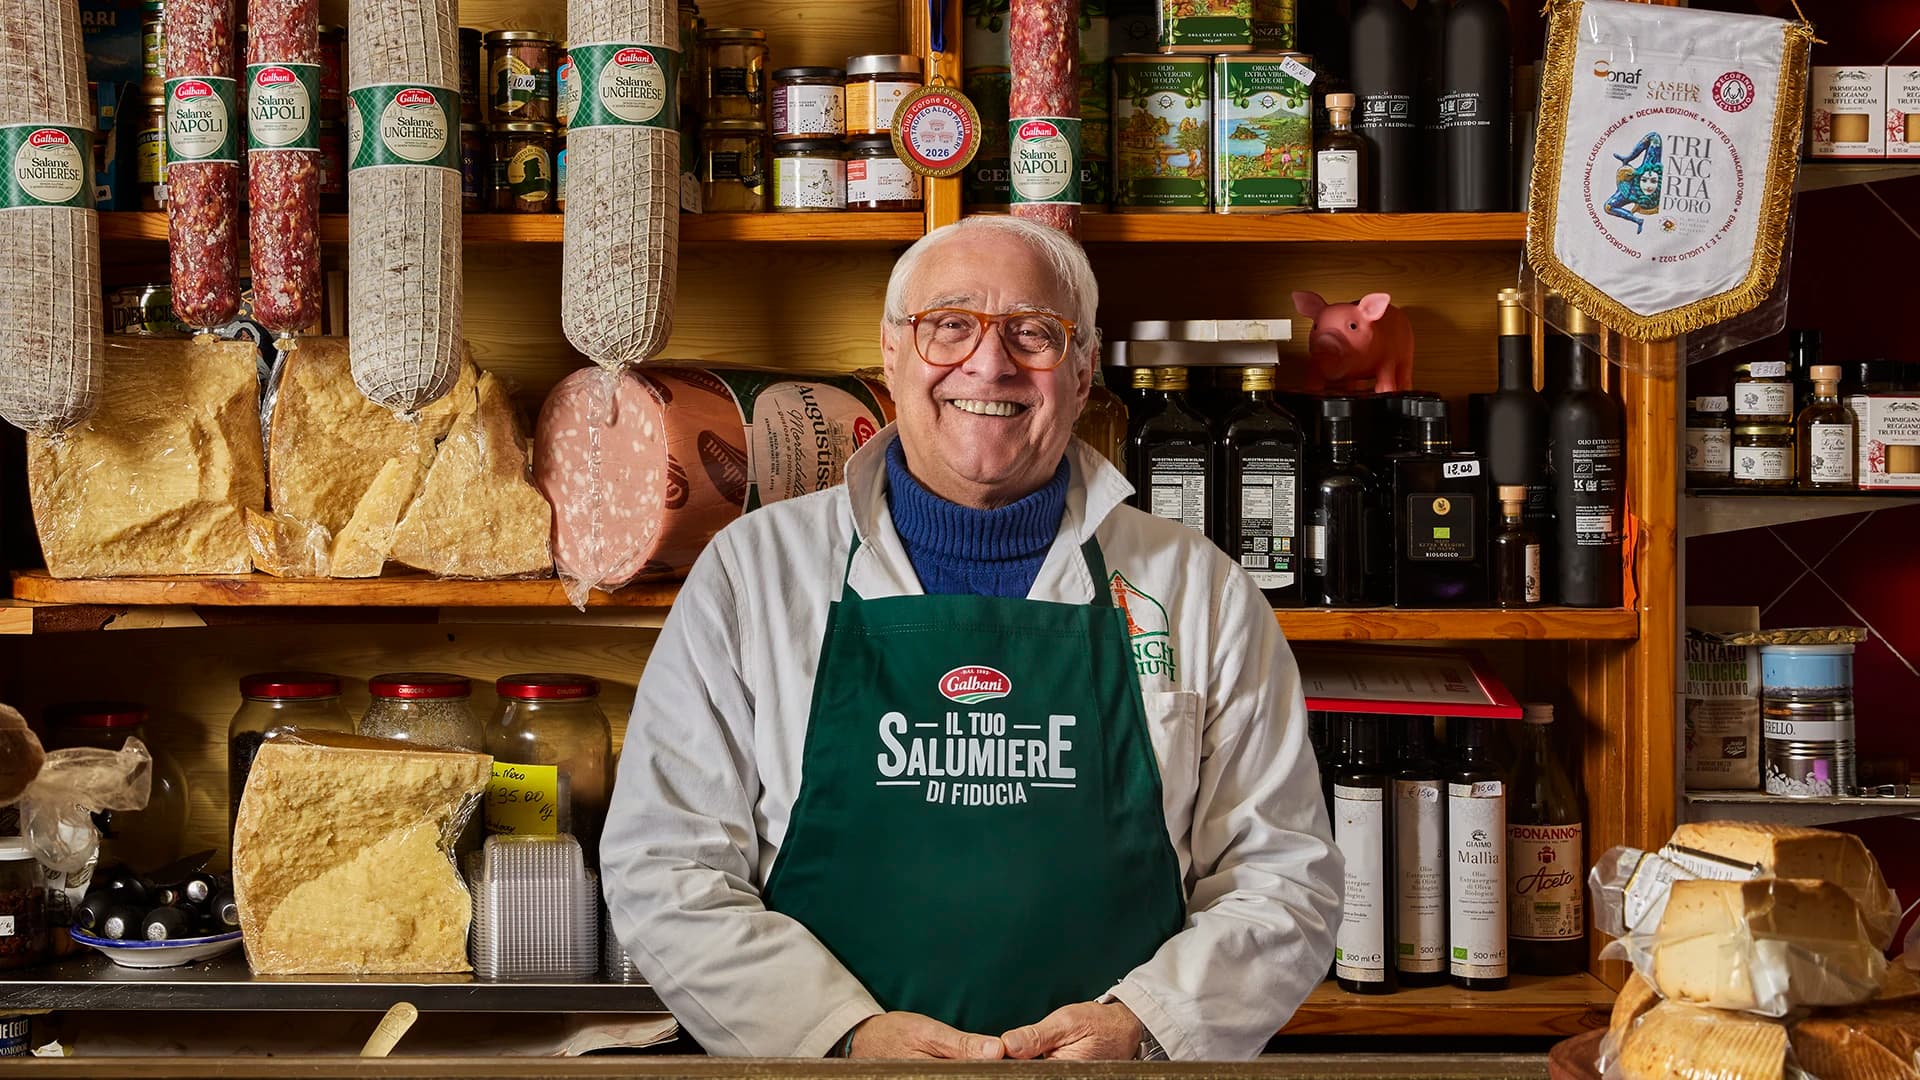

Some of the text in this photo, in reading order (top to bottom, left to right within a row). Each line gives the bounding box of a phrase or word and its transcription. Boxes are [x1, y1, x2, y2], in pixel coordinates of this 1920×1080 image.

[618, 53, 650, 63] Galbani
[1157, 64, 1175, 72] OLIO
[260, 72, 290, 83] Galbani
[616, 76, 652, 87] Salame
[1715, 73, 1753, 91] PECORINO
[178, 86, 207, 96] Galbani
[602, 86, 663, 101] UNGHERESE
[1647, 80, 1701, 93] CASEUS
[258, 94, 294, 106] Salame
[399, 93, 431, 104] Galbani
[1713, 94, 1752, 112] SICILIANO
[176, 108, 212, 119] Salame
[251, 105, 305, 121] NAPOLI
[903, 97, 971, 134] Club Corone Oro Sicilia
[1636, 107, 1699, 121] DECIMA EDIZIONE
[170, 119, 223, 135] NAPOLI
[397, 116, 433, 127] Salame
[911, 106, 963, 150] VIII TROFEO ALDO PALMERI
[384, 126, 445, 140] UNGHERESE
[1022, 126, 1052, 137] Galbani
[33, 134, 66, 144] Galbani
[925, 148, 950, 157] 2026
[1590, 137, 1607, 162] CASEUS
[1667, 135, 1713, 159] TRI
[1019, 149, 1057, 160] Salame
[32, 157, 69, 168] Salame
[1013, 159, 1067, 175] NAPOLI
[1667, 157, 1713, 179] NAC
[1707, 120, 1745, 207] TROFEO TRINACRIA D'ORO
[19, 168, 81, 181] UNGHERESE
[1583, 161, 1594, 201] REGIONALE
[1665, 176, 1710, 199] RIA
[1663, 196, 1711, 215] D'ORO
[1586, 199, 1607, 234] CASEARIO
[1605, 233, 1642, 259] CONCORSO
[1658, 255, 1678, 263] 2022
[1679, 246, 1706, 261] LUGLIO
[1689, 663, 1747, 682] BIOLOGICO
[947, 675, 1003, 692] Galbani
[1701, 682, 1748, 696] ITALIANO
[946, 711, 1006, 737] IL TUO
[877, 711, 1077, 780] SALUMIERE
[926, 779, 1028, 807] DI FIDUCIA
[1514, 828, 1575, 840] BONANNO
[1457, 850, 1499, 865] Mallia
[1459, 877, 1498, 885] Extravergine
[1516, 865, 1575, 894] Aceto
[1464, 890, 1494, 898] Biologico
[1420, 946, 1434, 954] 500
[1473, 952, 1488, 960] 500
